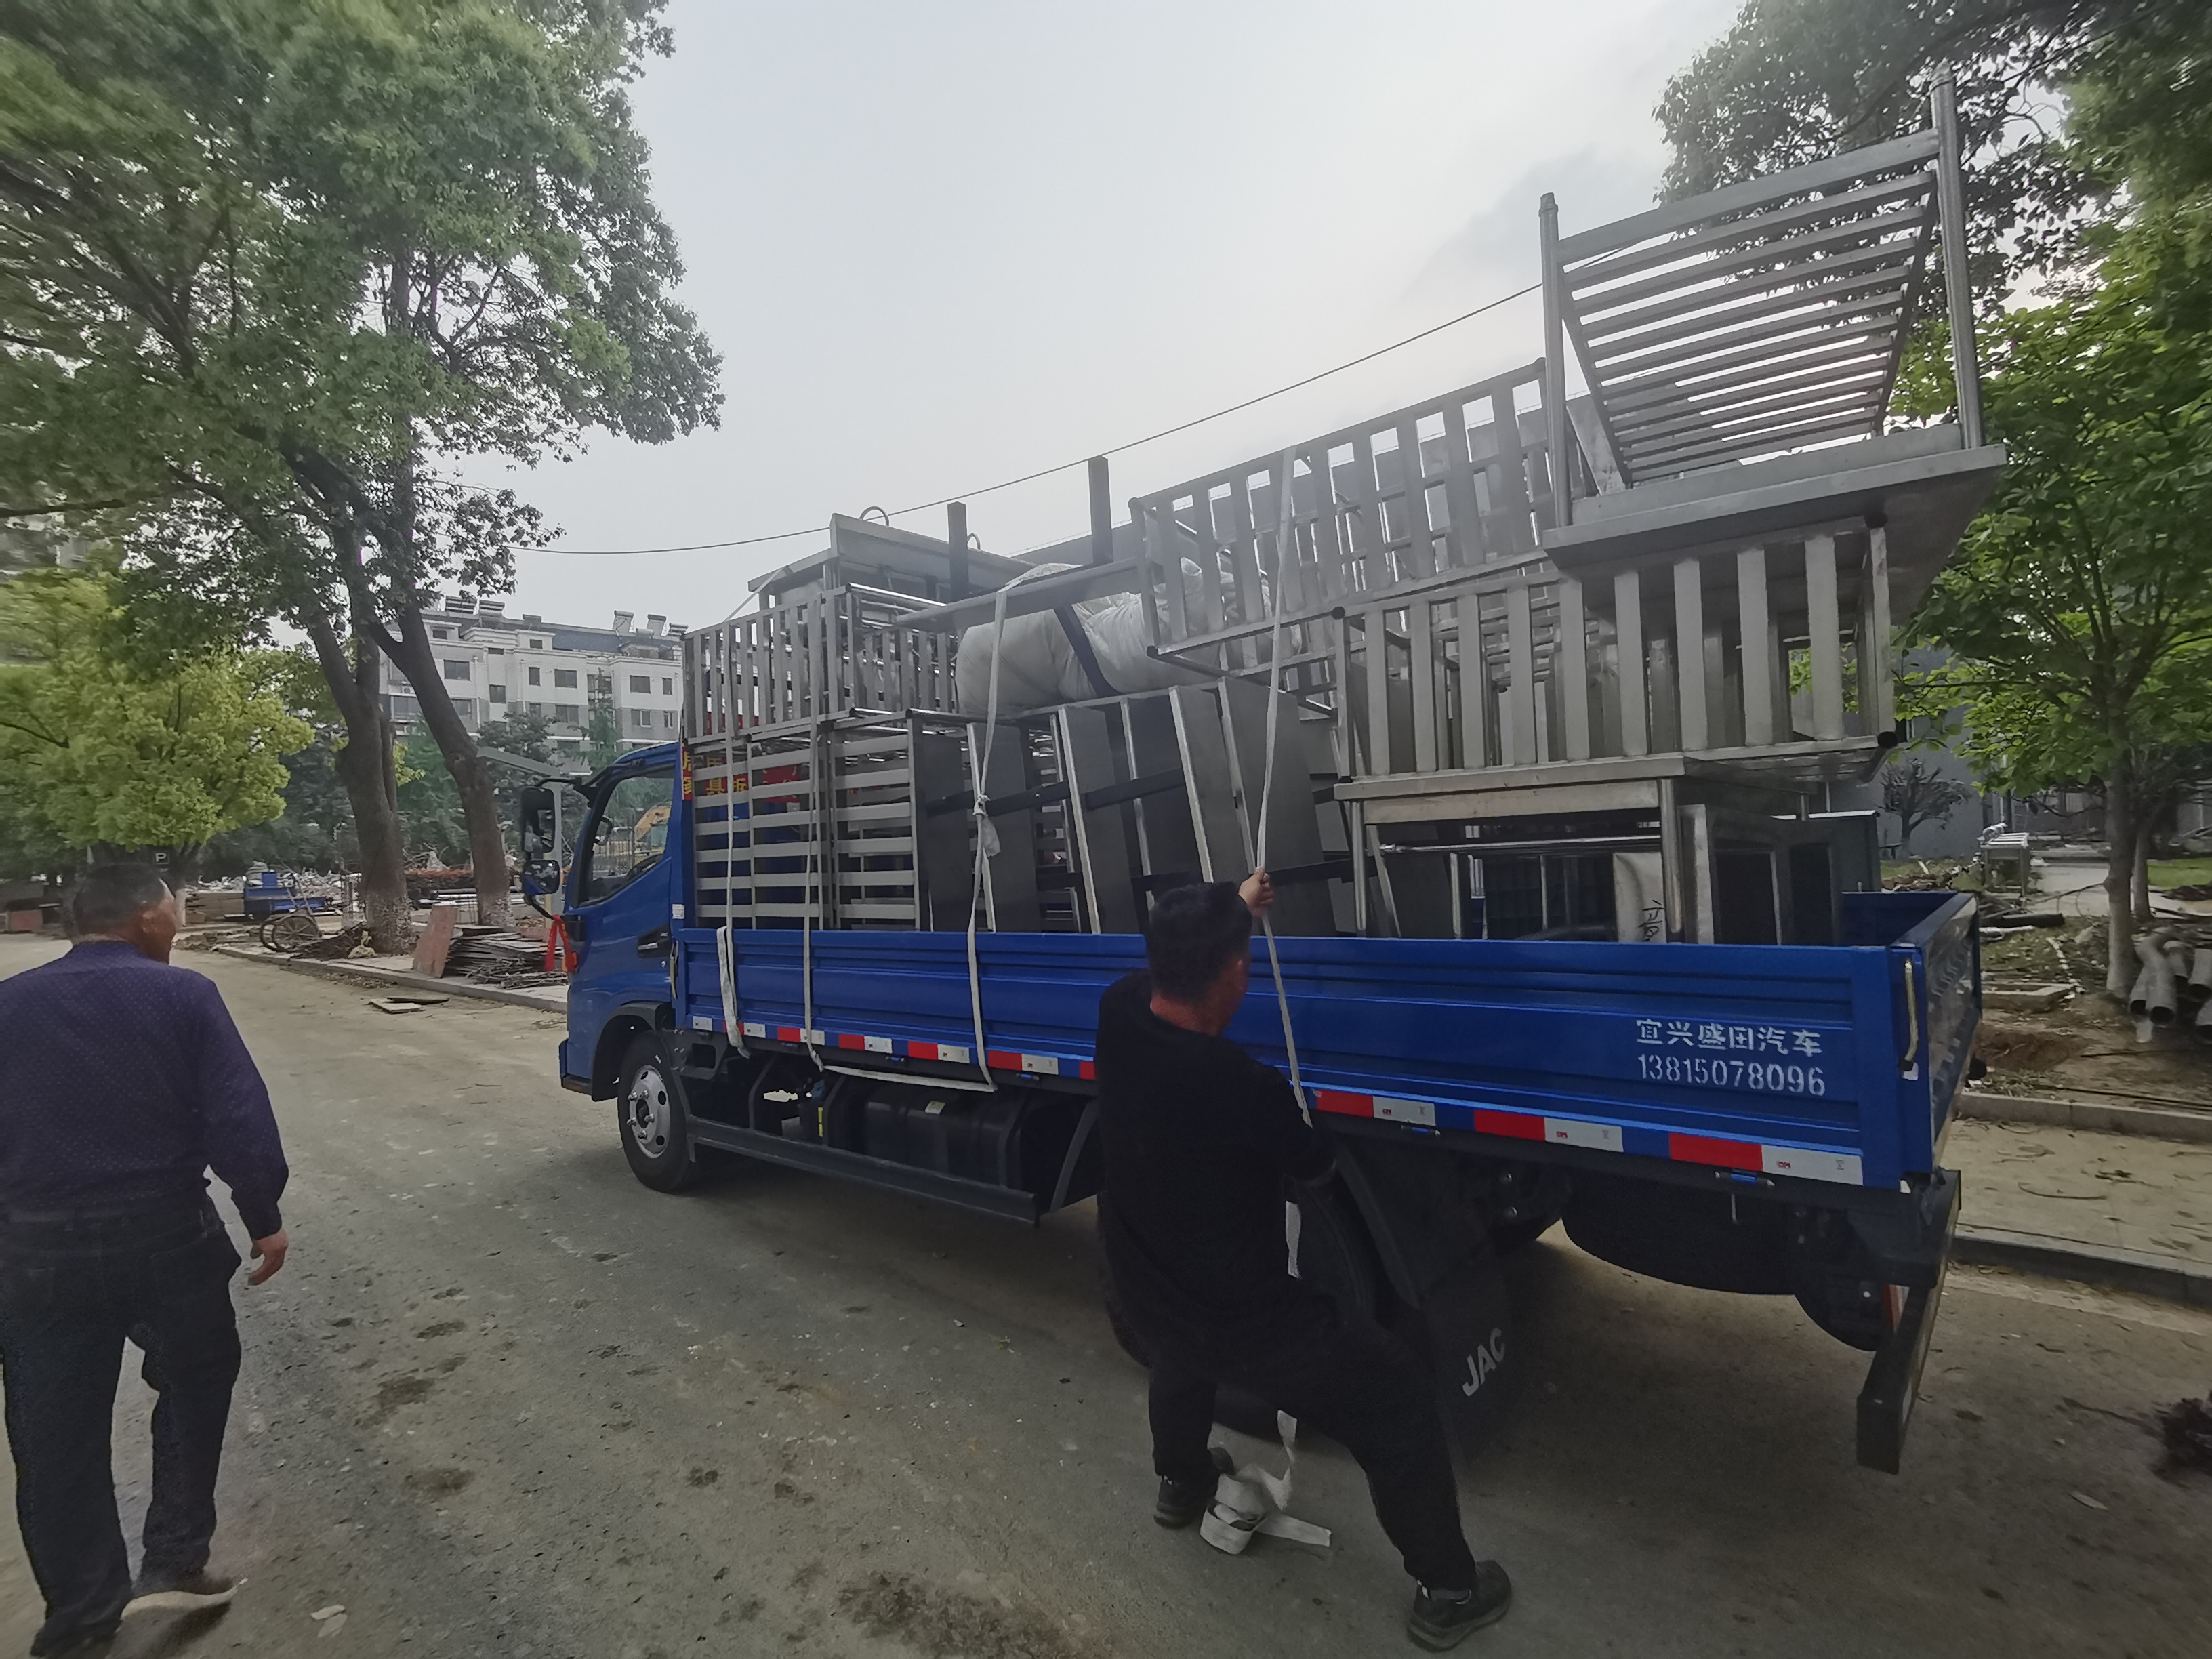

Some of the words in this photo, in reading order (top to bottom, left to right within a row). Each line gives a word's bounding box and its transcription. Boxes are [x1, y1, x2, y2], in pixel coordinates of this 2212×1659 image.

[155, 852, 167, 862] P
[1638, 1054, 1826, 1096] 13815078096
[1462, 1328, 1505, 1397] JAC
